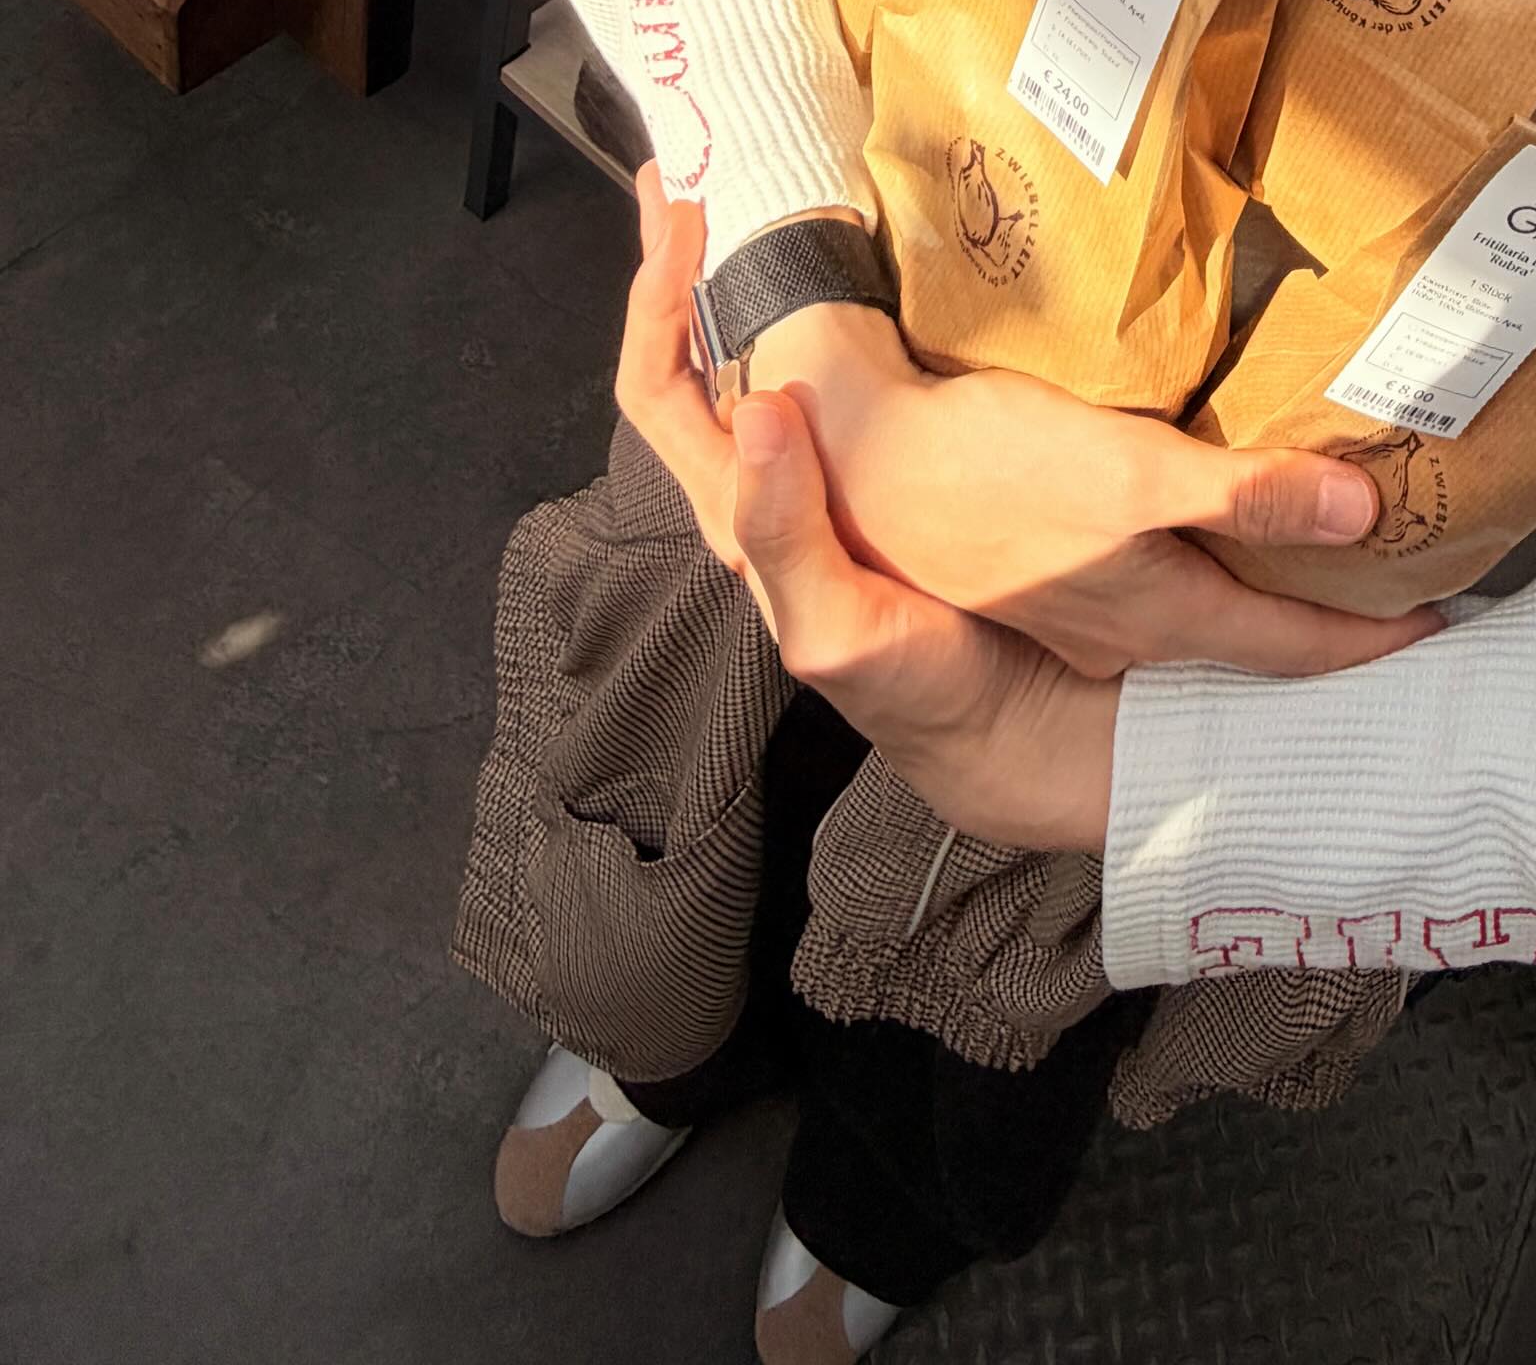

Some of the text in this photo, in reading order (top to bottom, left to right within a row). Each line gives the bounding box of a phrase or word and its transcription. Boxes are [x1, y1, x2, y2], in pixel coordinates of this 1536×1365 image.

[1371, 23, 1393, 34] der
[1398, 21, 1414, 31] an
[1043, 69, 1089, 117] € 24,00
[995, 147, 1039, 279] ZWIEBELZEIT
[1473, 232, 1529, 263] Fritillaria
[1490, 252, 1535, 277] 'Rubra'
[1470, 279, 1512, 303] 1 Stück
[1385, 379, 1434, 403] € 8,00
